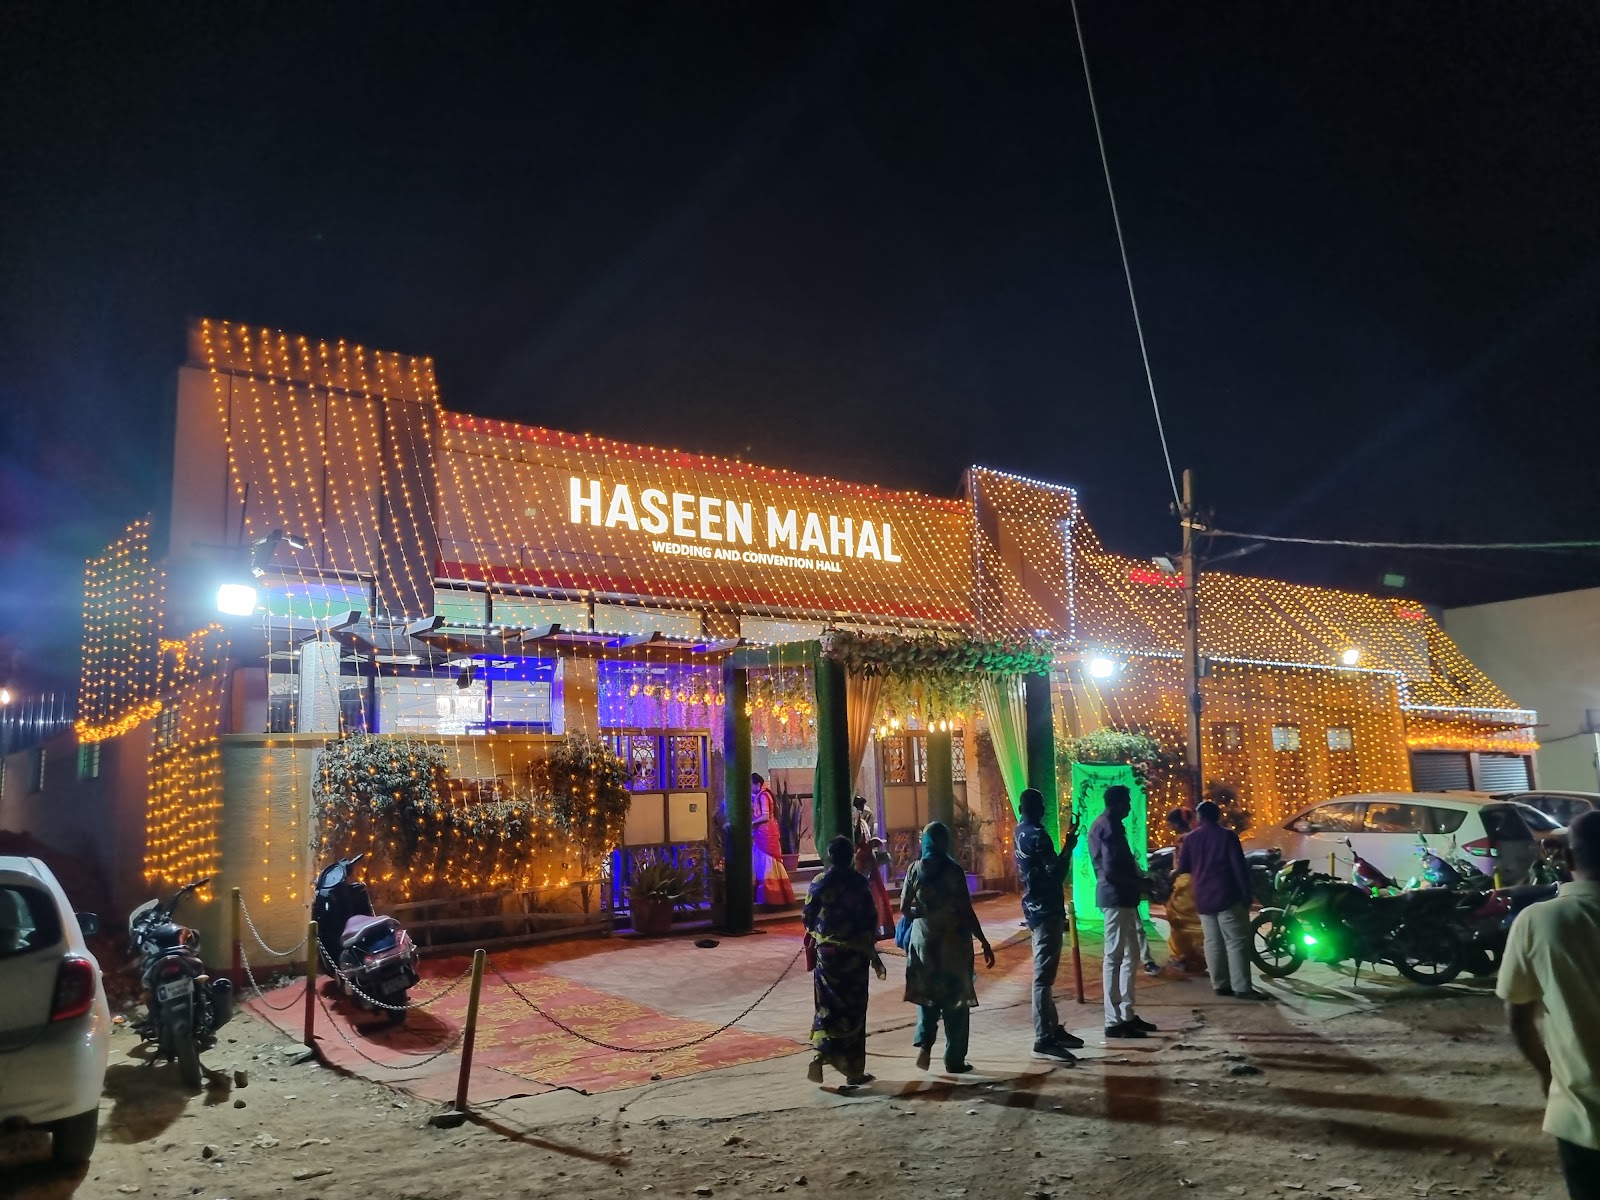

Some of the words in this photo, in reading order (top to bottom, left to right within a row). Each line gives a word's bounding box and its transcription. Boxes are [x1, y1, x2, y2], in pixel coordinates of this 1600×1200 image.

[570, 477, 753, 545] HASEEN
[768, 506, 902, 563] MAHAL
[652, 541, 711, 558] WEDDING
[714, 549, 740, 562] AND
[742, 552, 814, 570] CONVENTION
[816, 561, 842, 573] HALL
